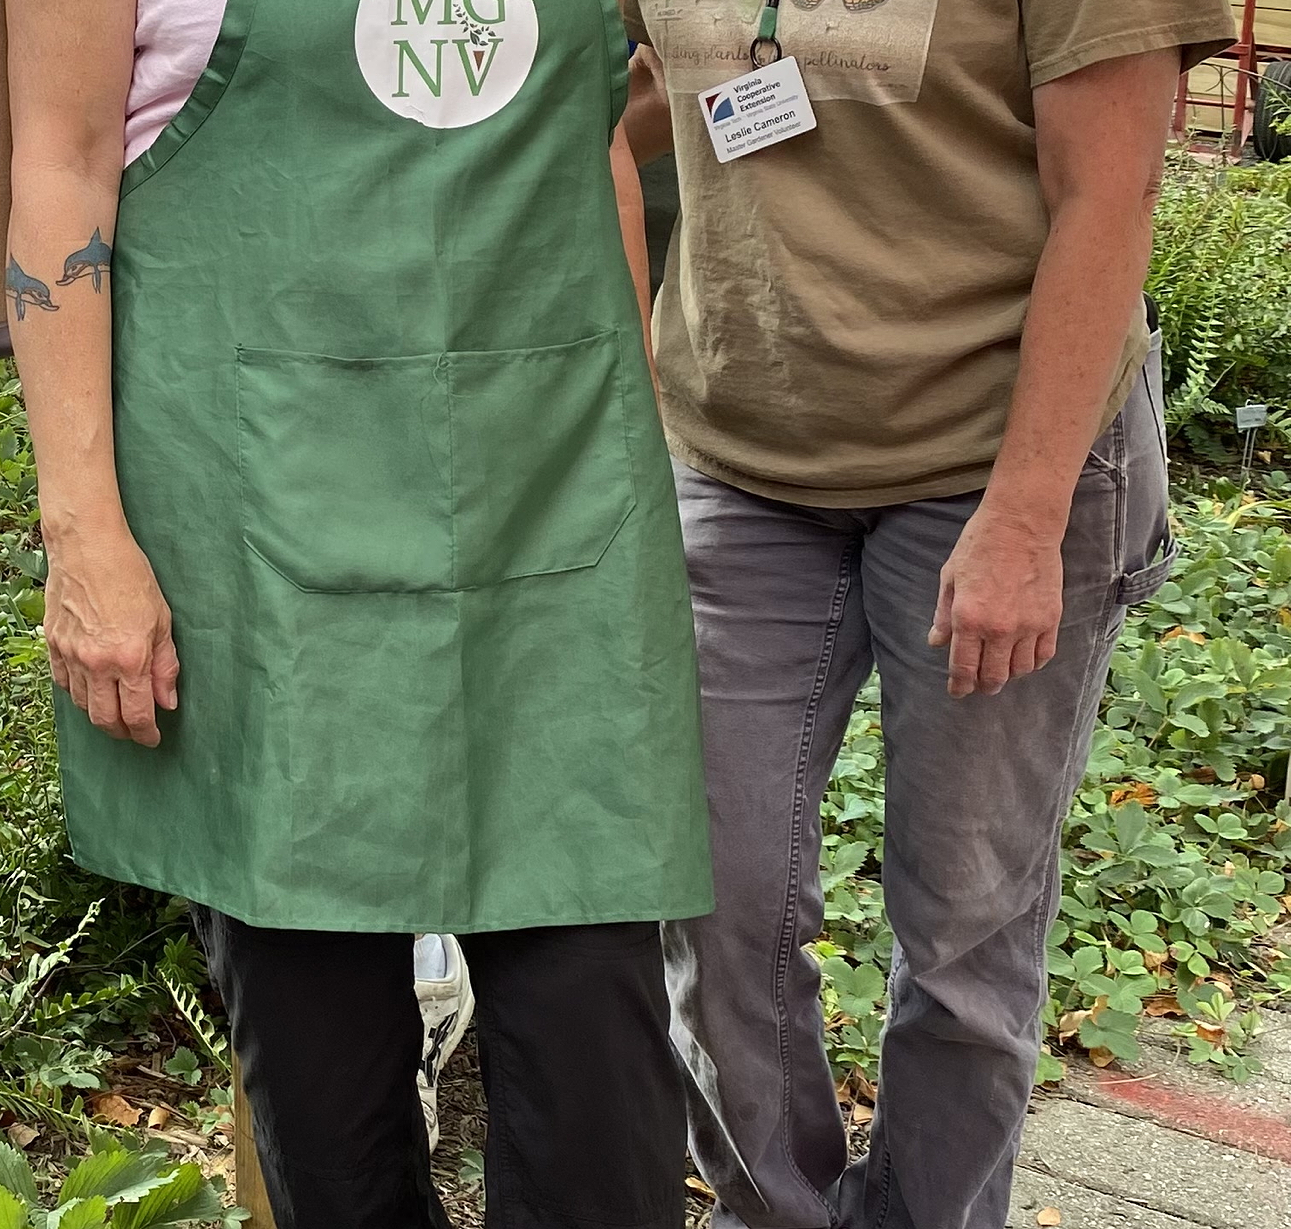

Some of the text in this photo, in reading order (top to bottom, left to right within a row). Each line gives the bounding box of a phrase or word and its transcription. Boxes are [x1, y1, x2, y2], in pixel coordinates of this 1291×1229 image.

[392, 39, 503, 97] NV
[804, 49, 890, 72] pollinators
[733, 78, 762, 93] Virginia
[737, 81, 780, 102] Cooperative
[740, 94, 775, 112] Extension
[725, 110, 796, 143] Leslie Cameron
[727, 122, 801, 153] Master Gardener Volunteer
